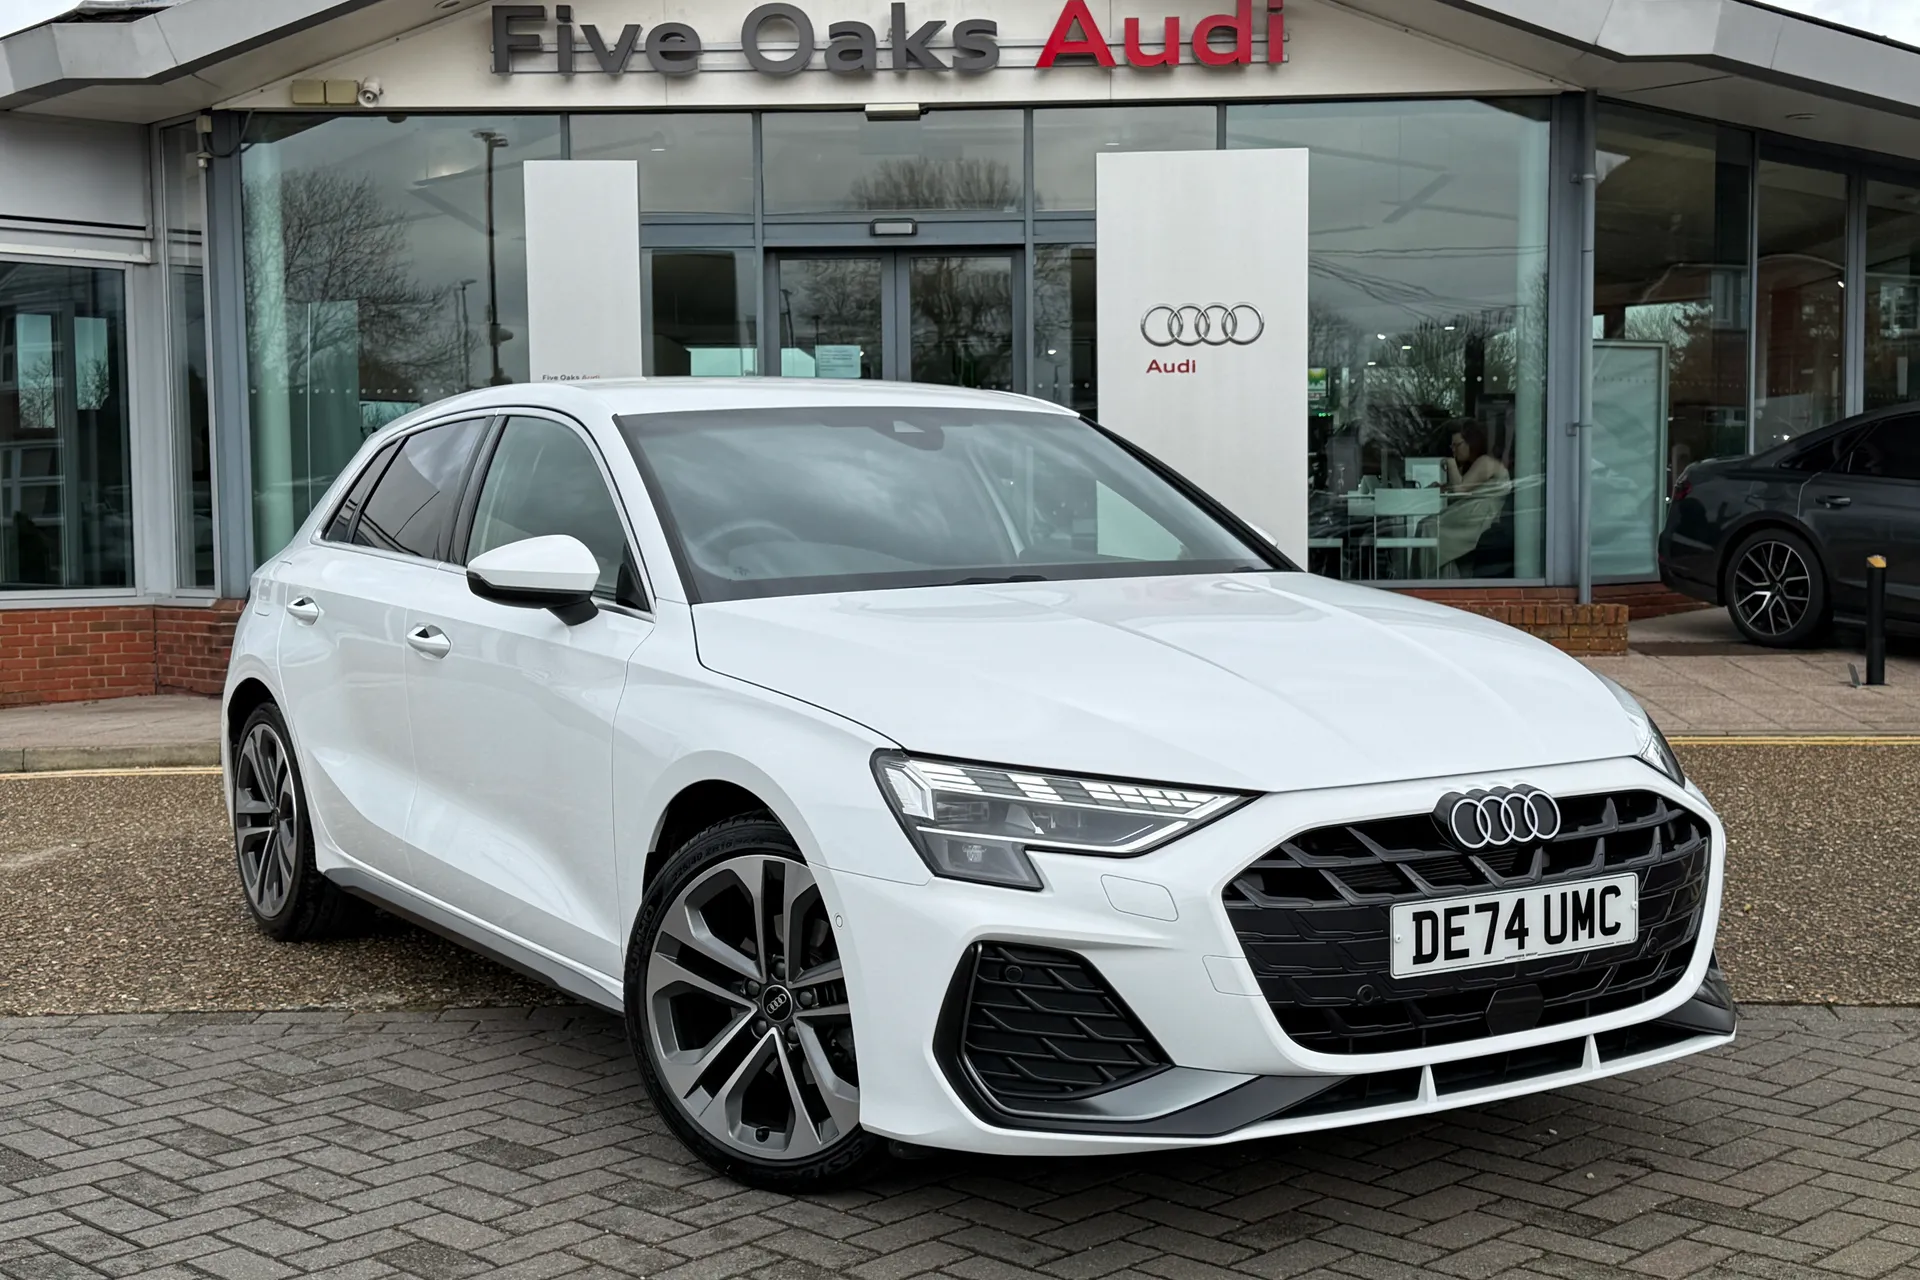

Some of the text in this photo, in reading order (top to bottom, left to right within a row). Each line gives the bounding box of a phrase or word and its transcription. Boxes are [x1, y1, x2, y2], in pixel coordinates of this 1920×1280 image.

[492, 0, 1284, 74] Five Oaks Audi
[1146, 359, 1196, 373] Audi
[1412, 885, 1621, 965] DE74 UMC
